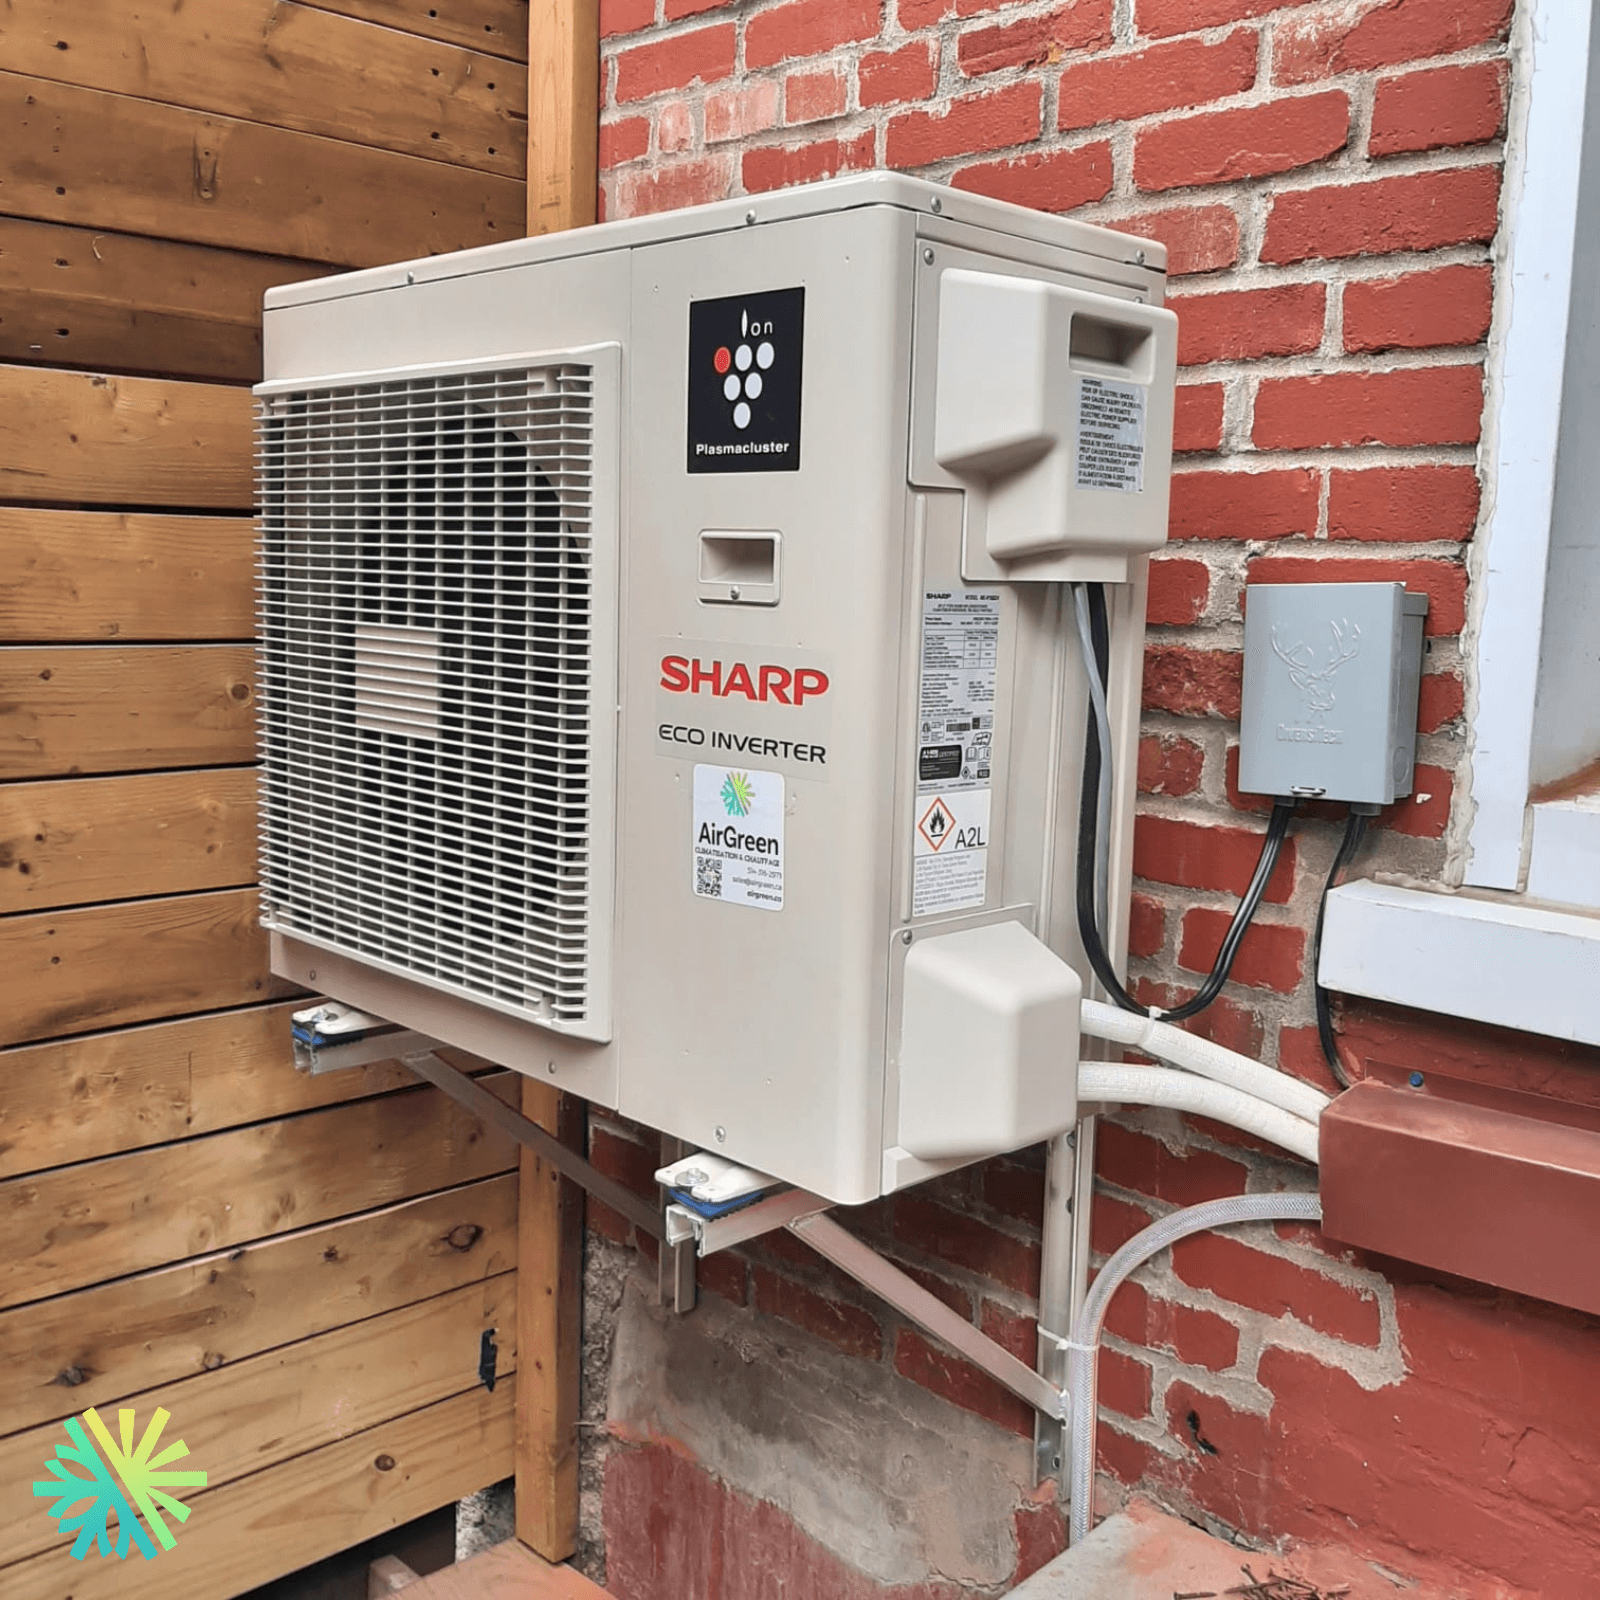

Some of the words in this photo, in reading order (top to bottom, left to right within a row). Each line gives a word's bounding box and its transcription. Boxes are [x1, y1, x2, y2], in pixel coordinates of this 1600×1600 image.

[741, 308, 773, 338] Ion
[696, 442, 790, 456] Plasmacluster
[660, 655, 829, 706] SHARP
[658, 724, 705, 745] ECO
[711, 731, 826, 764] INVERTER
[698, 821, 779, 856] AirGreen
[954, 826, 986, 849] A2L
